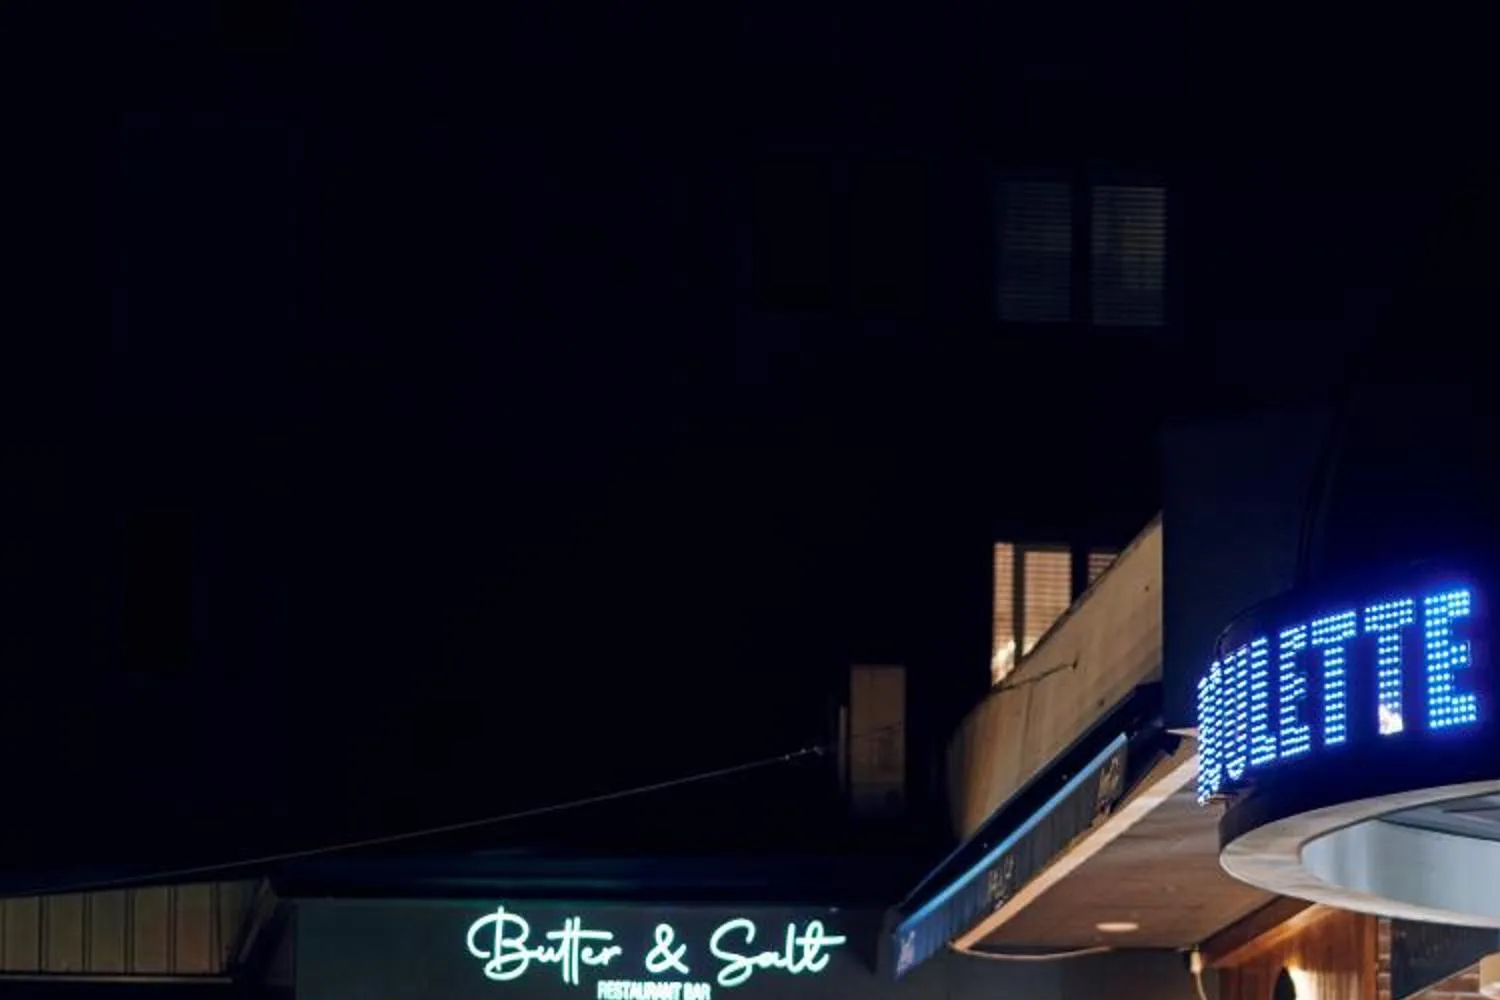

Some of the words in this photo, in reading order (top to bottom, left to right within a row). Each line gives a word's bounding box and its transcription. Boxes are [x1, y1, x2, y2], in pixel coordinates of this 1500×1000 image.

[466, 906, 623, 985] Butter
[644, 923, 690, 975] &
[708, 918, 847, 987] Salt
